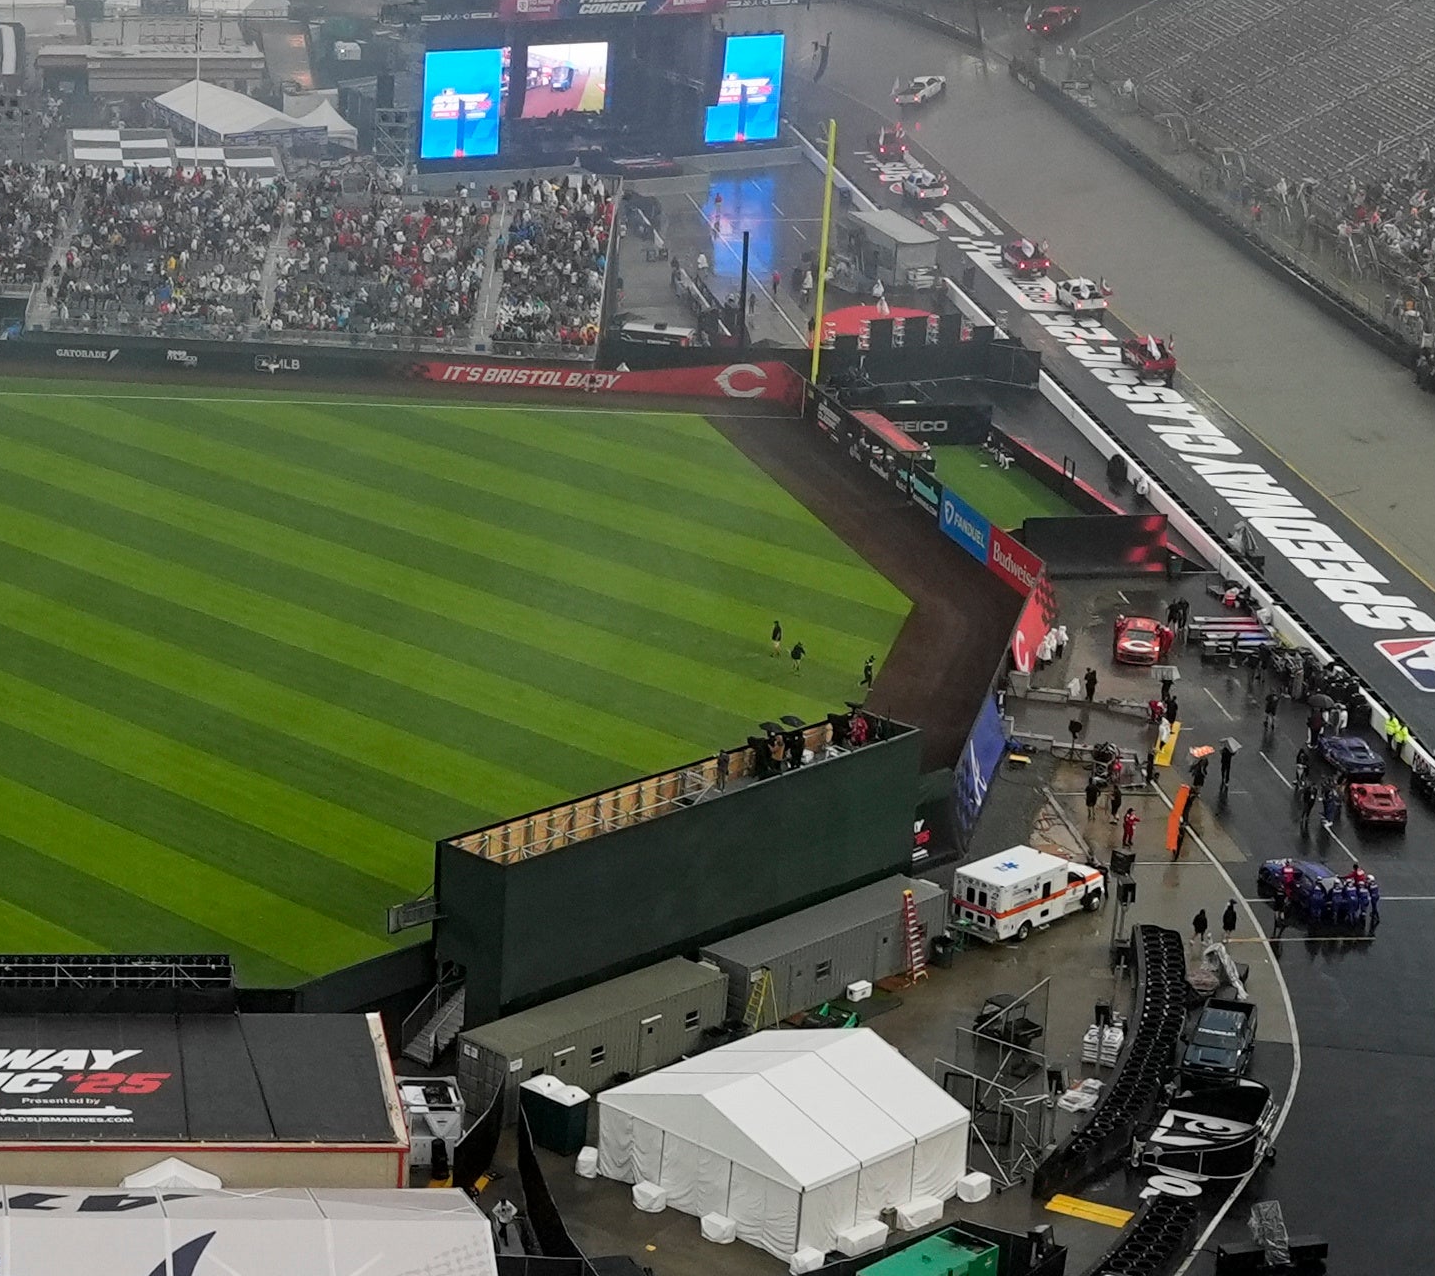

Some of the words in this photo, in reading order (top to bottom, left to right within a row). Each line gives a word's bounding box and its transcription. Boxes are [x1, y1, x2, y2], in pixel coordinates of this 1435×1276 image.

[579, 1, 647, 15] CONCERT
[55, 348, 109, 360] GATORADE
[442, 365, 483, 382] IT'S
[481, 367, 563, 386] BRISTOL
[564, 373, 622, 389] BABY
[1065, 344, 1244, 456] CLASSIC
[893, 420, 949, 433] GEICO
[953, 511, 987, 550] FANDUEL
[65, 1072, 172, 1095] '25
[21, 1097, 74, 1105] Presented
[75, 1097, 101, 1108] by
